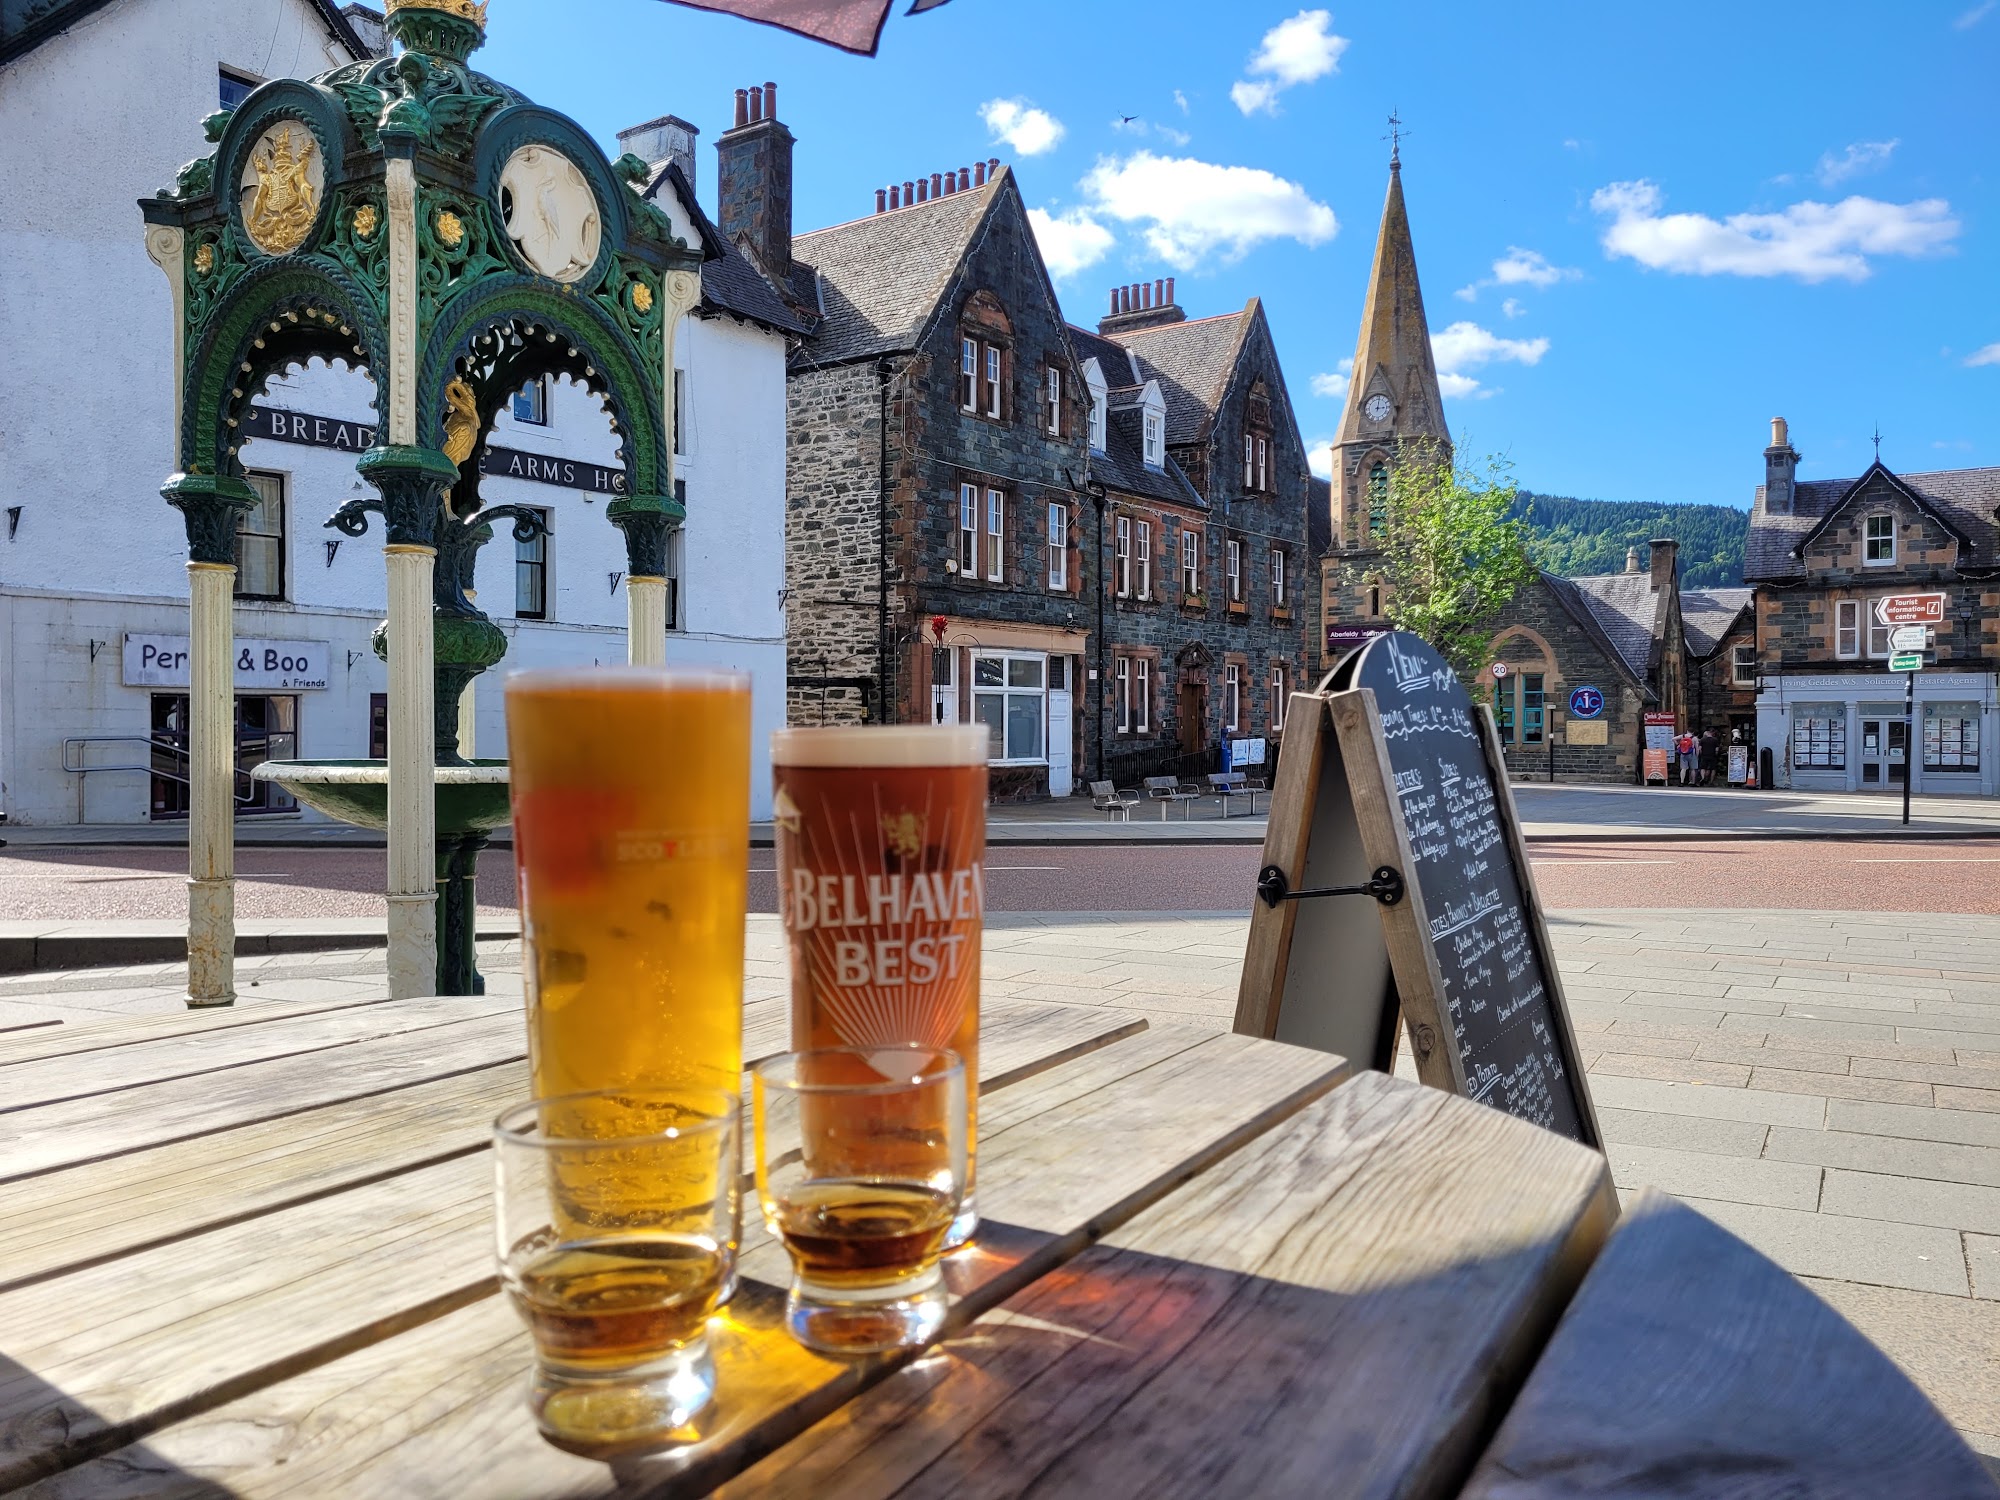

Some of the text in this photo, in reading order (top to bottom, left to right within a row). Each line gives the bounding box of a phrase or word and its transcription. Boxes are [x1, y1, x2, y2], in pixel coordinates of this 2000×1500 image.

[508, 454, 575, 483] ARMS
[142, 645, 308, 672] Per & Boo
[282, 678, 325, 688] & Friends
[1782, 679, 1806, 687] Irving
[1864, 677, 1904, 686] Solicitors
[1919, 677, 1945, 685] Estate
[1947, 677, 1977, 686] Agents
[793, 863, 983, 932] BELHAVEN
[835, 934, 965, 987] BEST
[1475, 1063, 1498, 1083] POTATO
